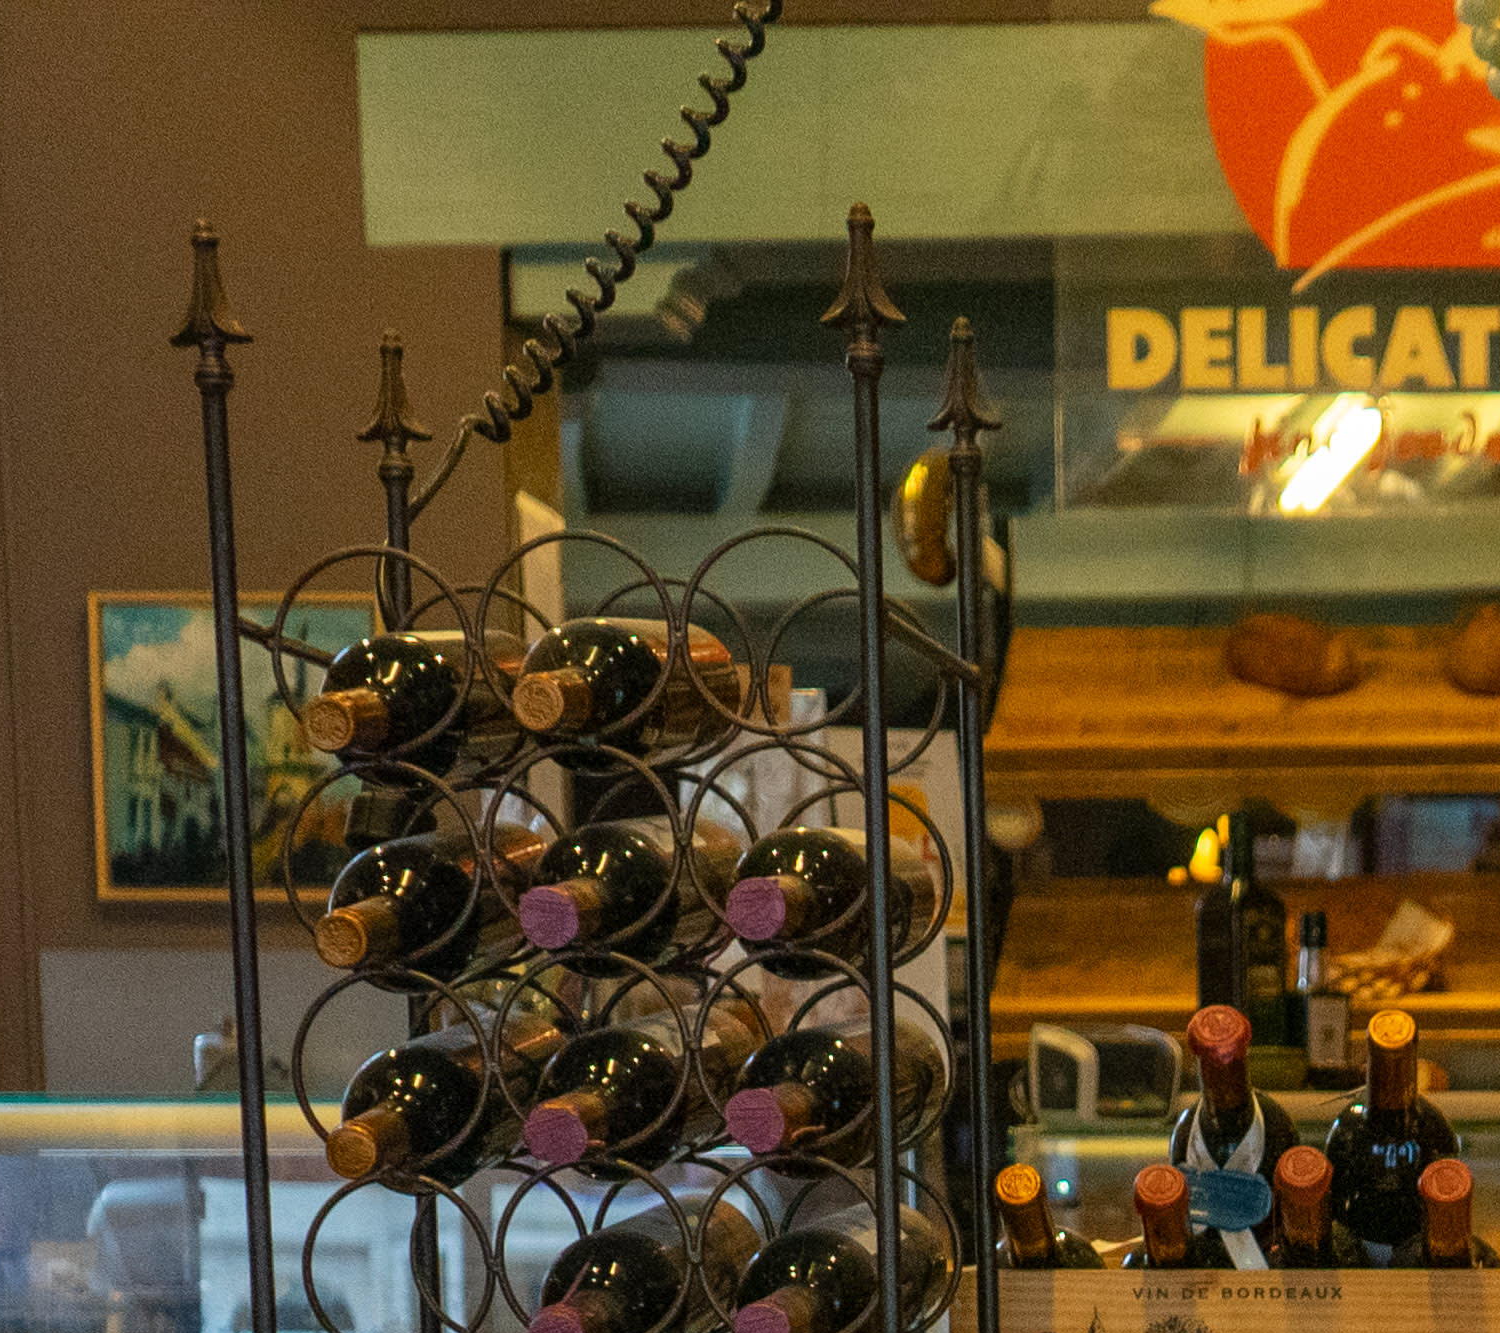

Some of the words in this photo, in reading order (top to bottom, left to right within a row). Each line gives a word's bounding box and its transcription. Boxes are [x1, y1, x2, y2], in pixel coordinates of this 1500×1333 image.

[1133, 1287, 1170, 1301] VIN
[1192, 1287, 1214, 1301] DE
[1221, 1286, 1344, 1301] BORDEAUX
